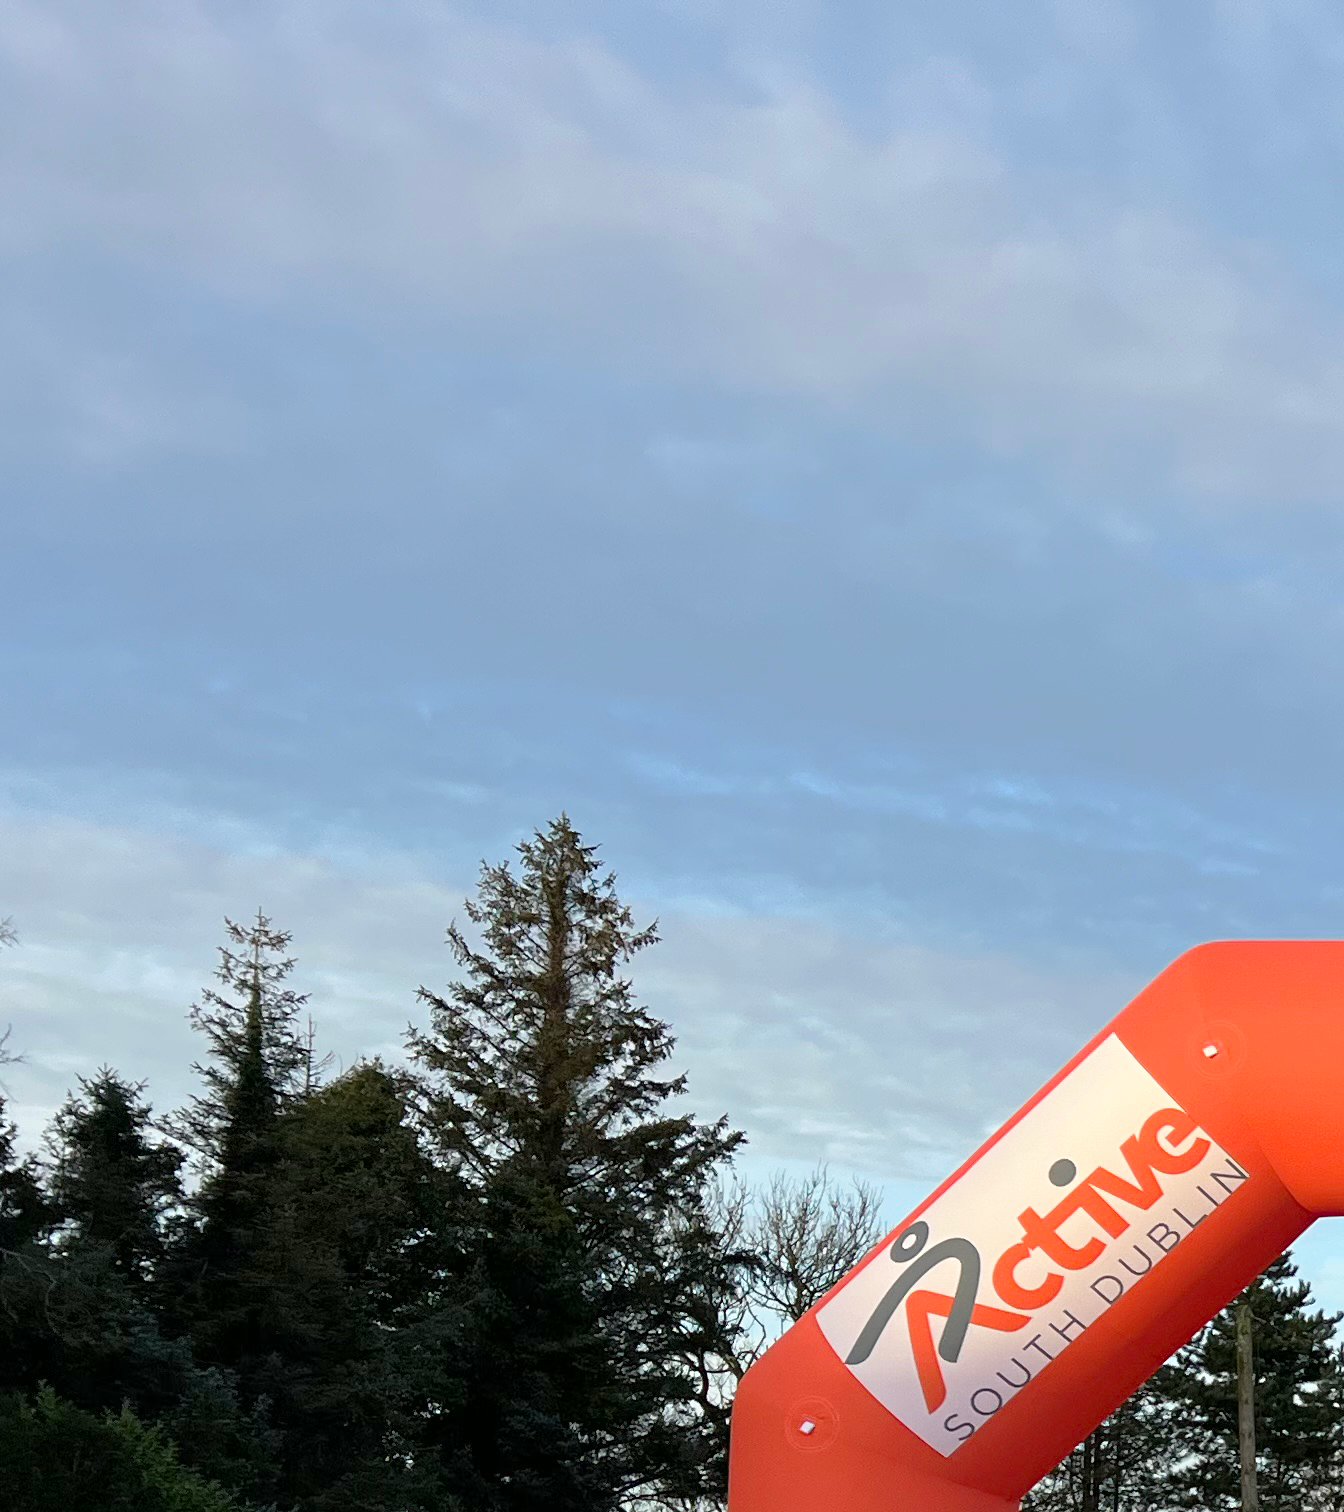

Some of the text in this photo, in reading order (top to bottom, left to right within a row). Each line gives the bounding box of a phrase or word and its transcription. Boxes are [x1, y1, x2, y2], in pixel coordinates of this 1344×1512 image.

[844, 1107, 1212, 1415] Active
[943, 1157, 1251, 1442] SOUTH DUBLIN
